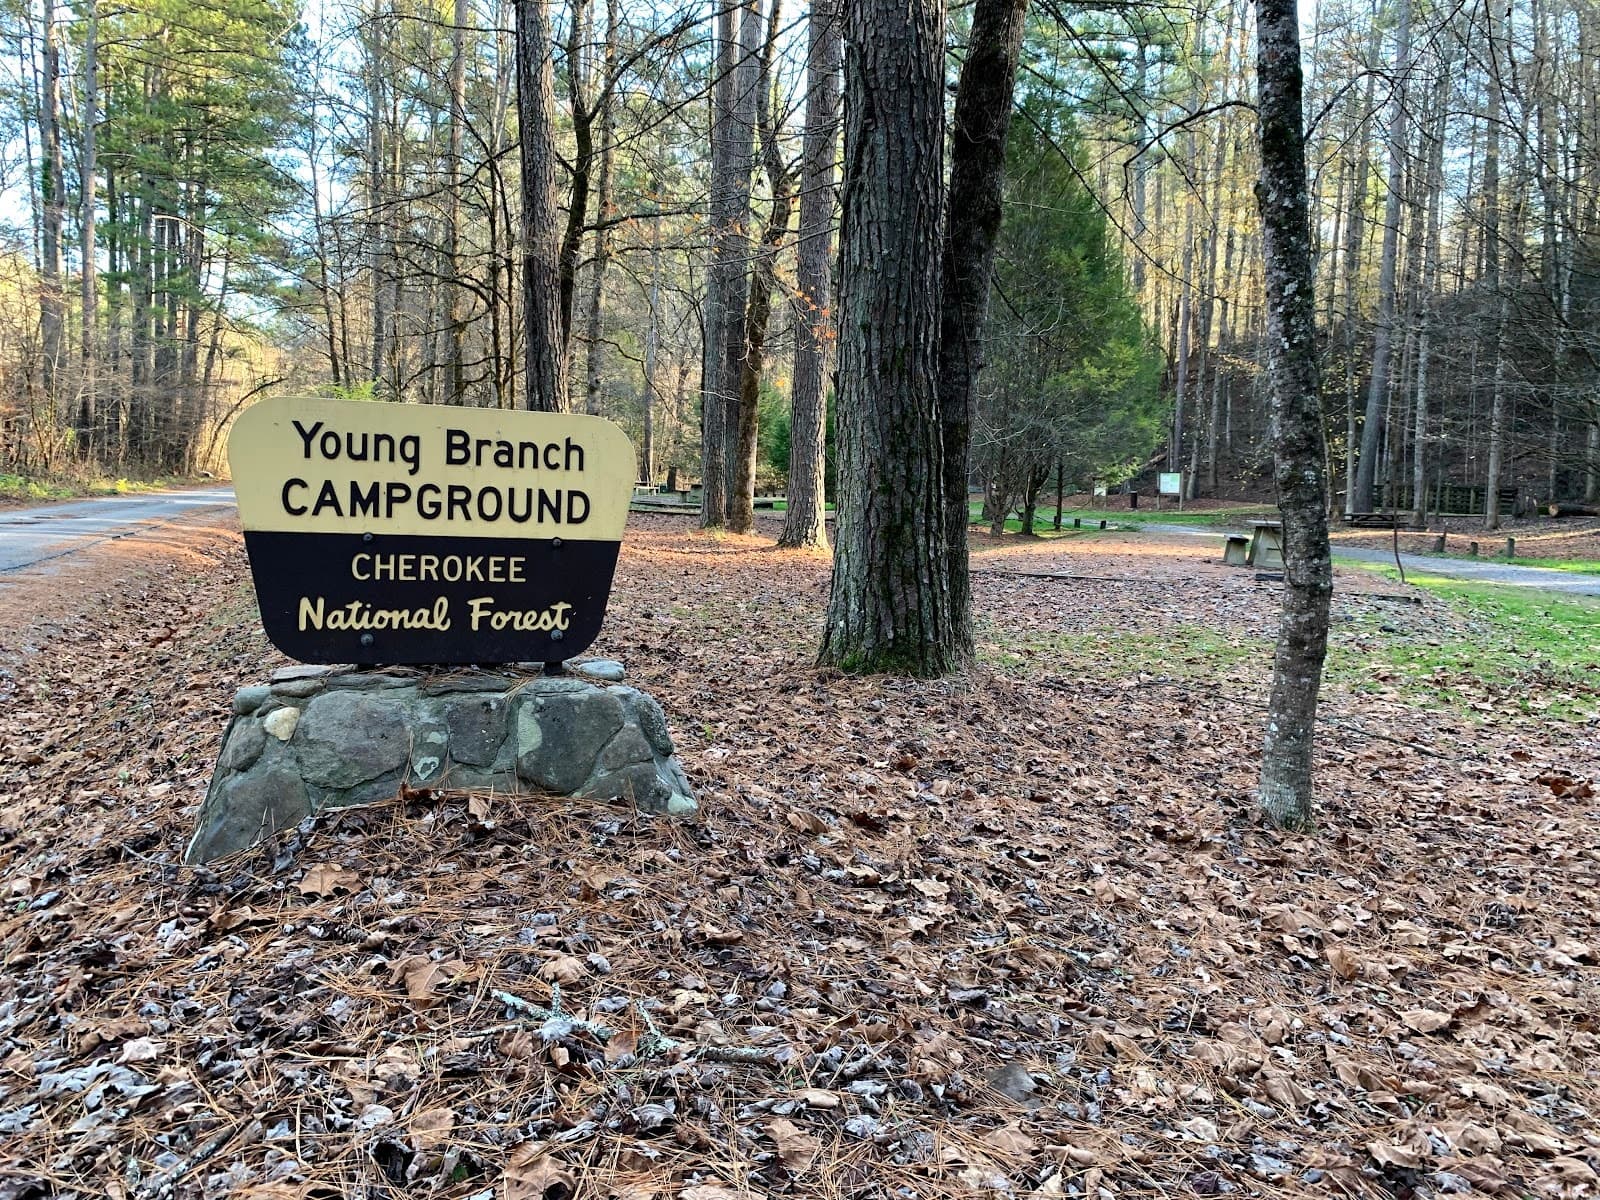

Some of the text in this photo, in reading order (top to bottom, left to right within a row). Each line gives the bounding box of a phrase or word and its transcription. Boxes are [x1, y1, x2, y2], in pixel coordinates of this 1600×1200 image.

[292, 420, 584, 475] Young Branch
[281, 478, 591, 524] CAMPGROUND
[351, 553, 526, 583] CHEROKEE
[298, 597, 572, 632] National Forest
